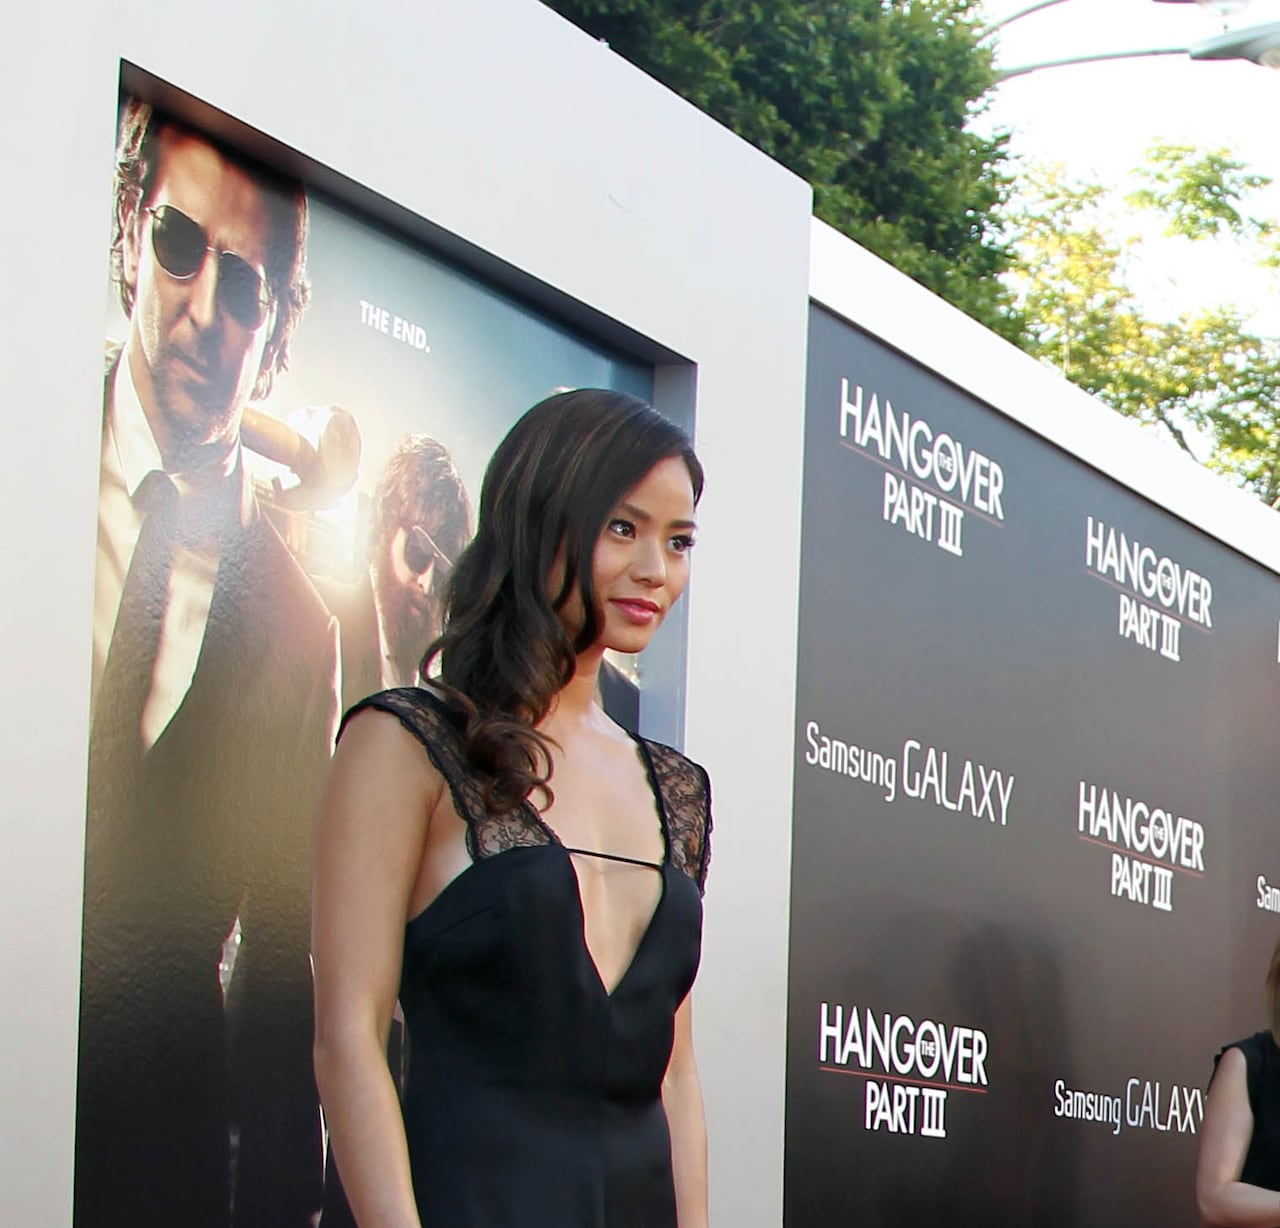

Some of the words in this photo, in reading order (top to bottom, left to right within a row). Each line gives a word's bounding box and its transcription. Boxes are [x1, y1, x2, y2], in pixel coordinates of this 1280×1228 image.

[360, 300, 390, 333] THE
[392, 316, 430, 353] END.
[840, 378, 1005, 520] HANGOVER
[884, 473, 937, 543] PART
[936, 500, 964, 556] III
[1087, 517, 1213, 628] HANGOVER
[1120, 594, 1162, 651] PART
[1159, 615, 1181, 661] III
[806, 722, 896, 802] Samsung
[903, 740, 1014, 826] GALAXY
[1079, 782, 1205, 872] HANGOVER
[1112, 854, 1153, 905] PART
[1151, 867, 1173, 911] III
[820, 1003, 988, 1085] HANGOVER
[920, 1038, 935, 1057] THE
[866, 1082, 921, 1135] PART
[919, 1088, 947, 1138] III
[1055, 1079, 1121, 1135] Samsung
